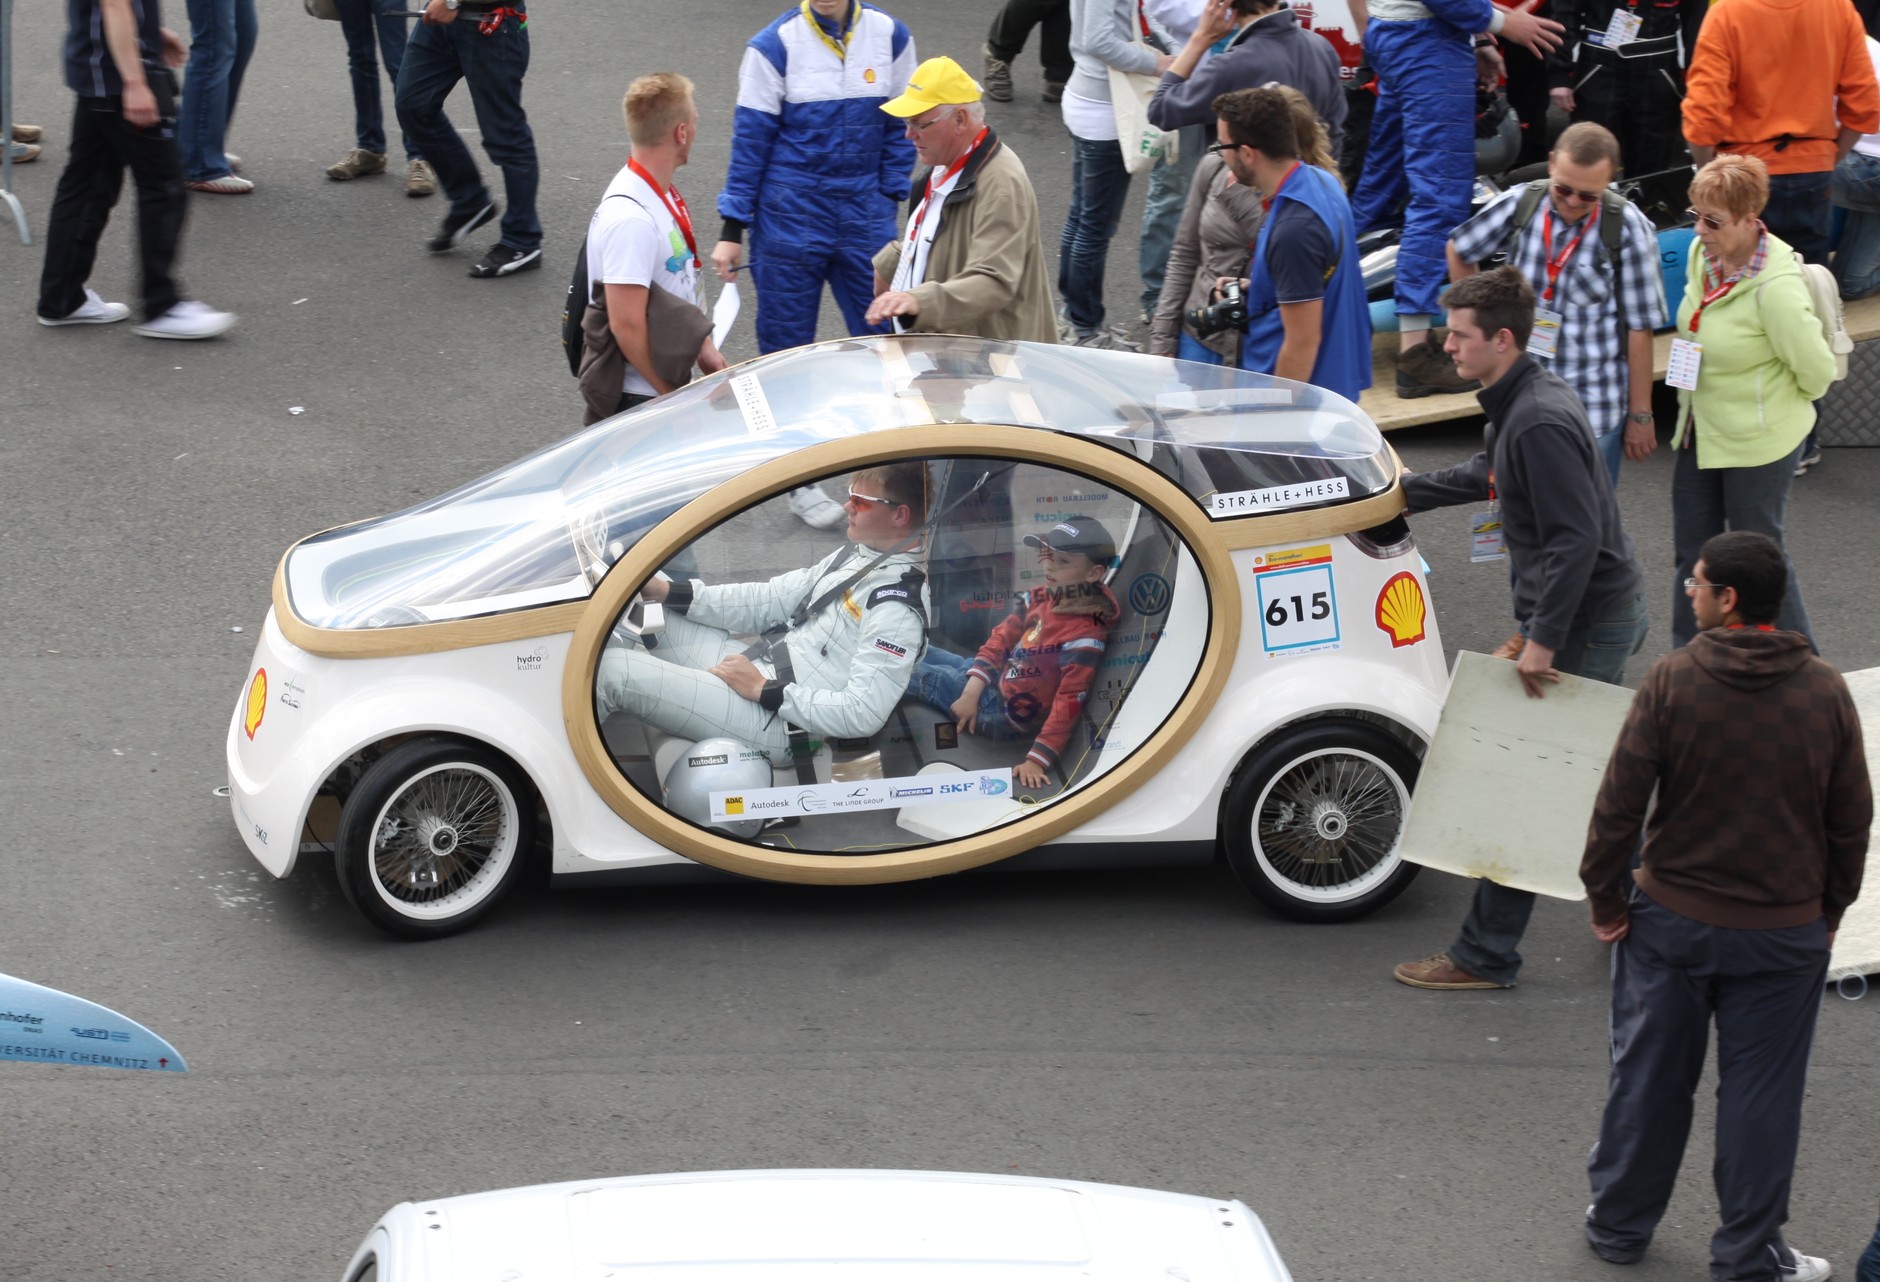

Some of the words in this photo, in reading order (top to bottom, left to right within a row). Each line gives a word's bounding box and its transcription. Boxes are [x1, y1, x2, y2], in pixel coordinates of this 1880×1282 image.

[876, 589, 908, 599] sparco
[1265, 592, 1331, 626] 615
[517, 655, 542, 664] hydro
[517, 663, 542, 671] kultur
[739, 749, 770, 758] metabo
[690, 755, 726, 766] Autodesk
[897, 787, 932, 797] MICHELIN
[939, 782, 975, 794] SKF
[750, 799, 790, 809] Autodesk
[70, 1051, 149, 1069] CHEMNITZ
